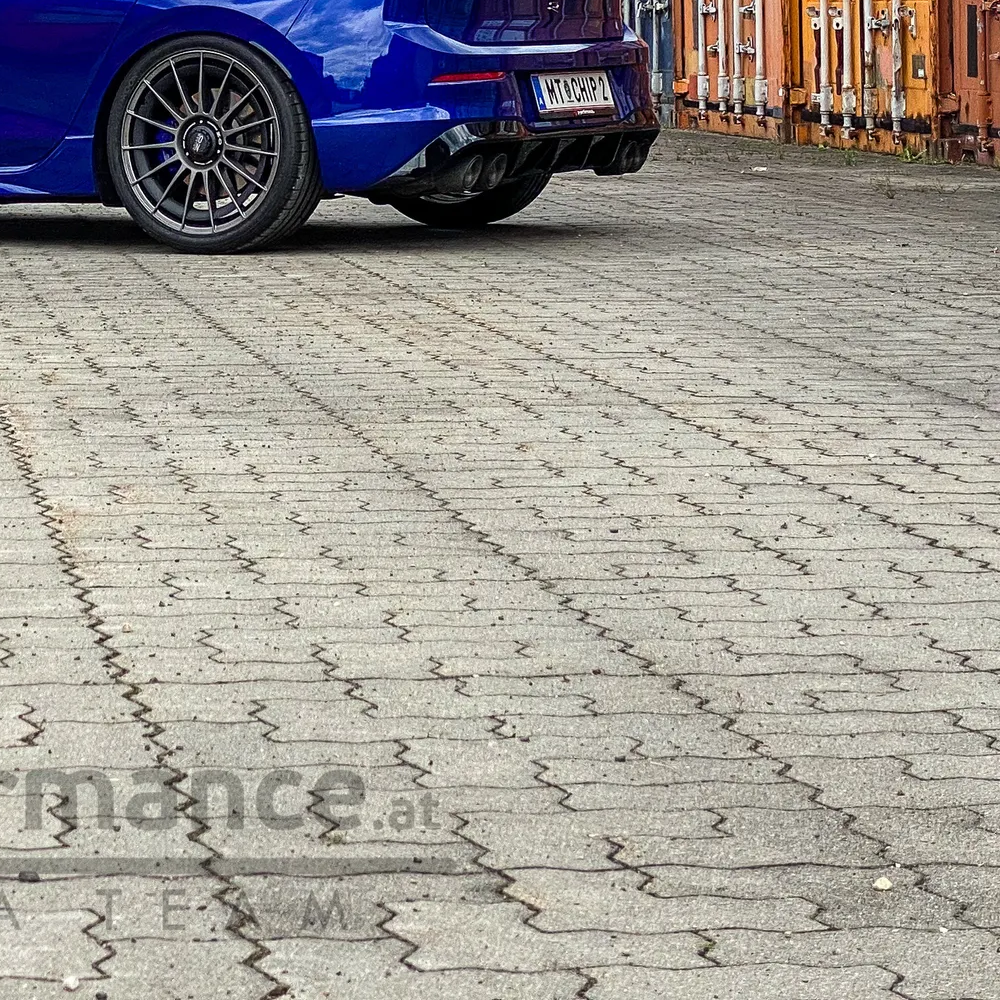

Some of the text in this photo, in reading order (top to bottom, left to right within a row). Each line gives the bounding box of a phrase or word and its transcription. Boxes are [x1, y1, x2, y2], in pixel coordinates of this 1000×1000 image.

[545, 75, 608, 105] MT CHIP 2
